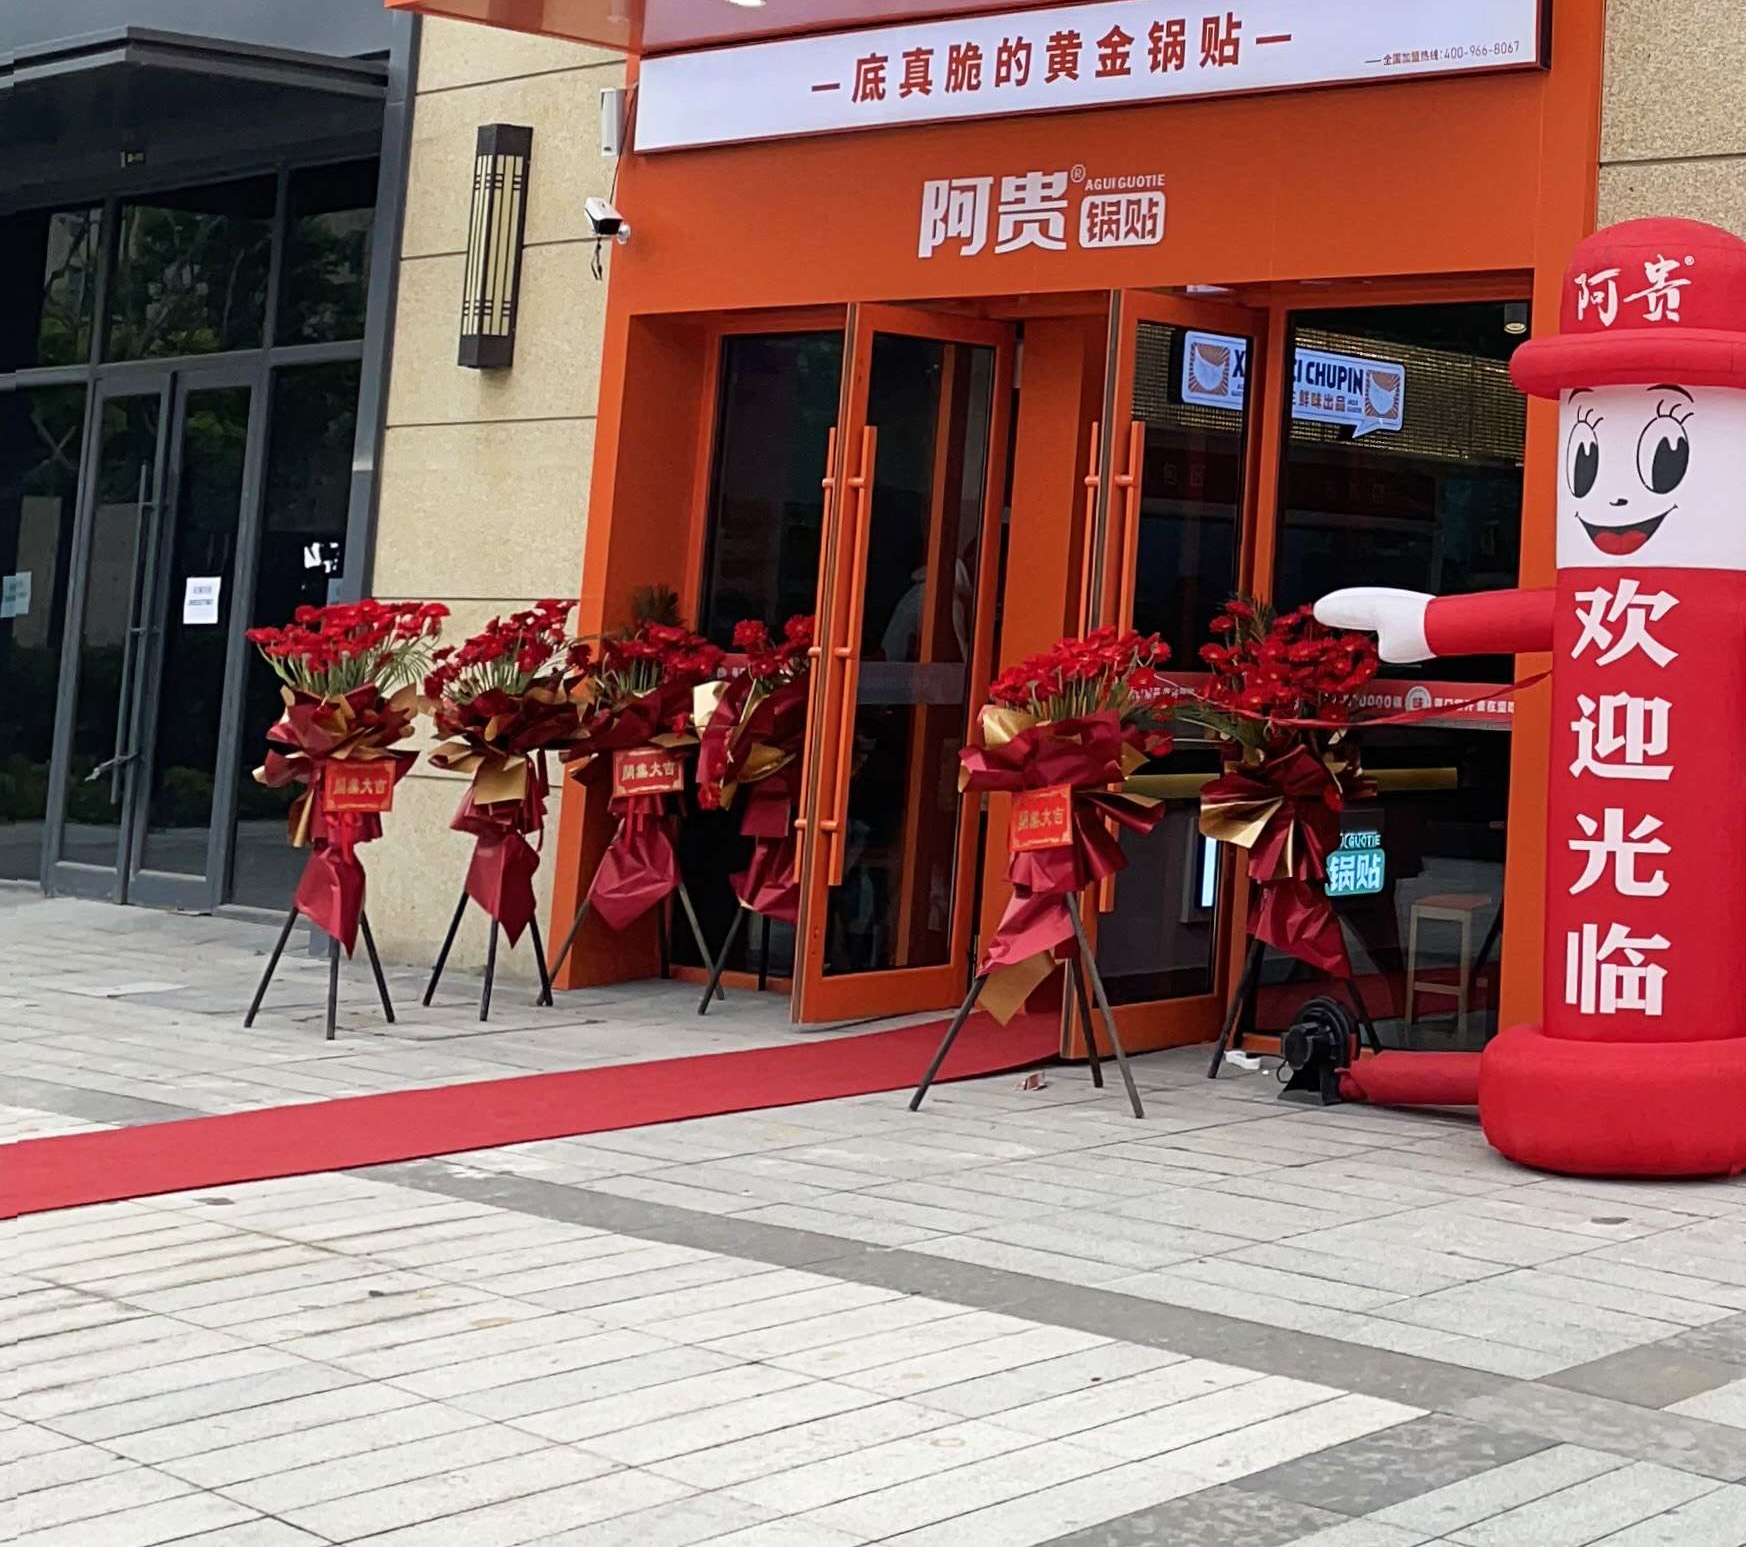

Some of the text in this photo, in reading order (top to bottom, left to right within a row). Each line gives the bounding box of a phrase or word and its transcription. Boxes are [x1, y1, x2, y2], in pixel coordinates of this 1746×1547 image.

[918, 171, 1160, 258] 阿贵 锅贴
[1574, 254, 1692, 327] 阿贵
[1565, 577, 1681, 1017] 欢迎光临
[1329, 853, 1381, 891] 锅贴
